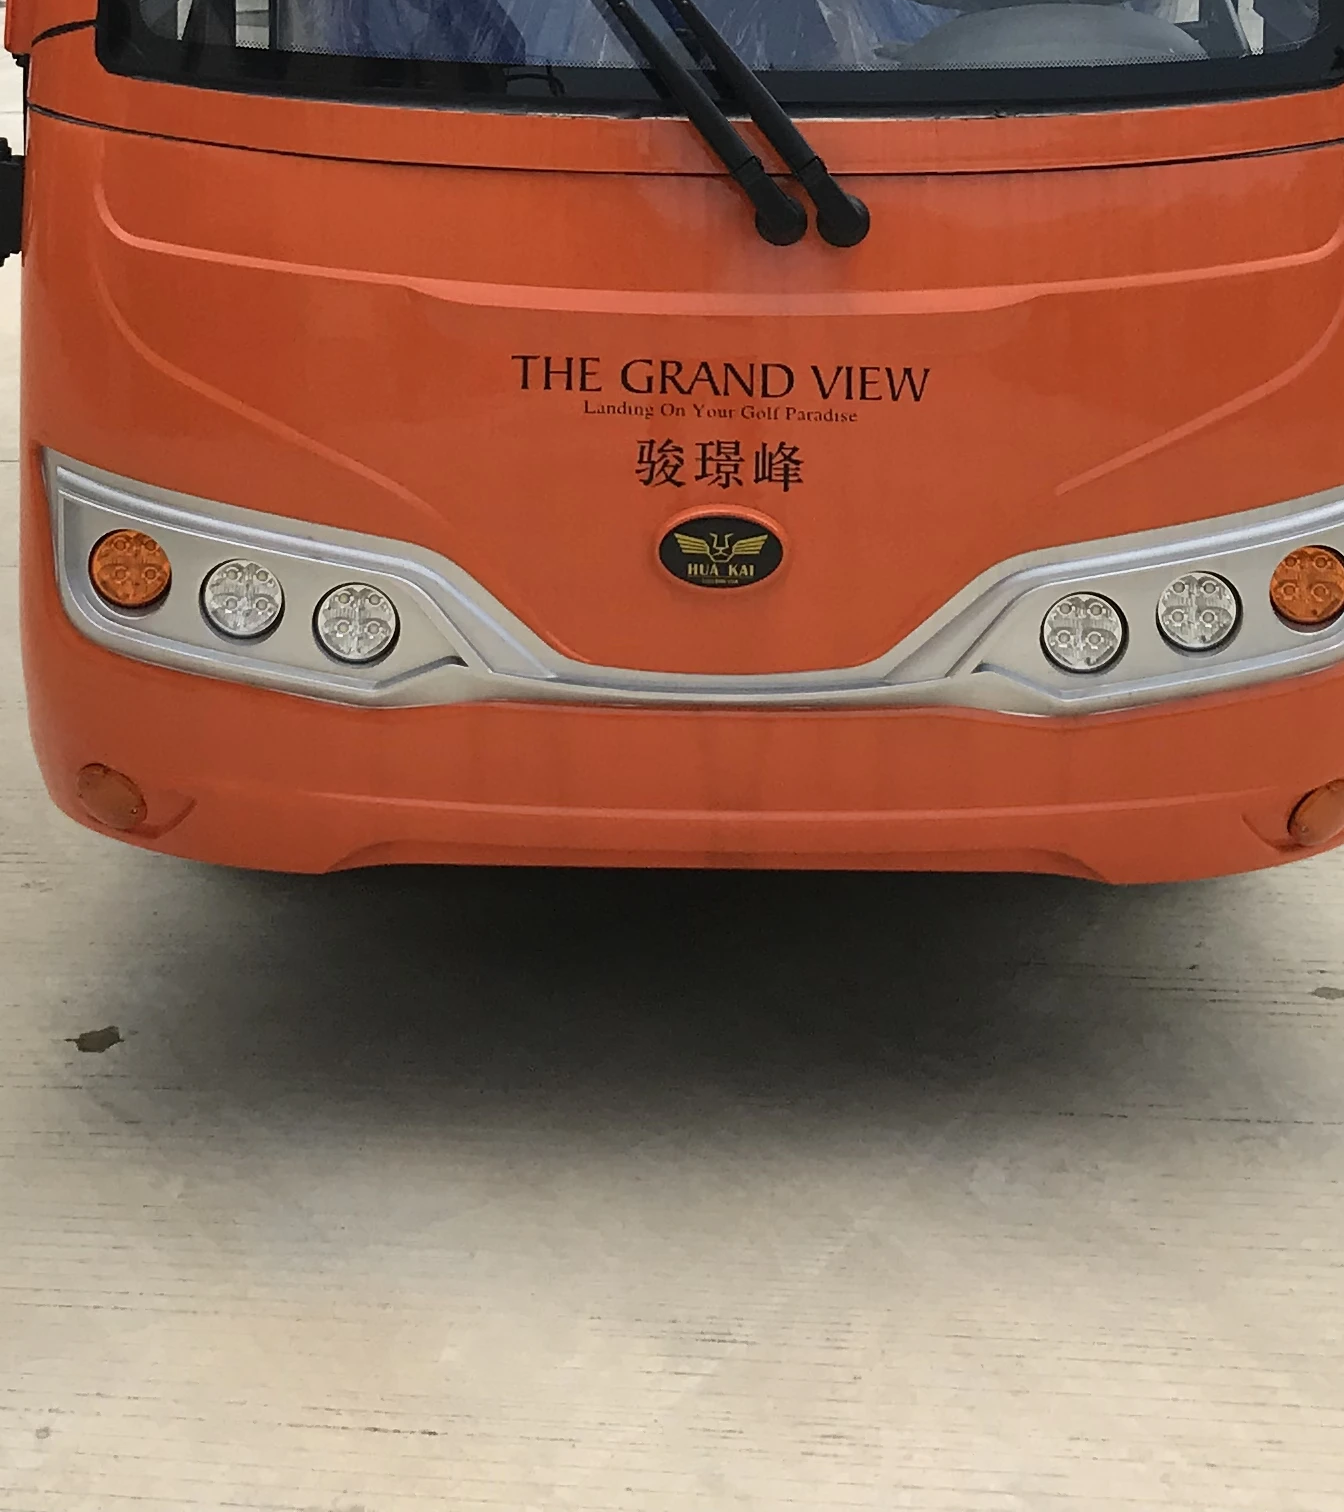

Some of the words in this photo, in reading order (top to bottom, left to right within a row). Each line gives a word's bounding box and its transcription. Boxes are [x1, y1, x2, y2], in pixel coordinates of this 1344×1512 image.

[511, 354, 602, 392] THE
[620, 358, 795, 398] GRAND
[810, 365, 931, 403] VIEW
[583, 399, 654, 420] Landing
[660, 403, 686, 417] On
[692, 404, 736, 419] Your
[740, 405, 781, 421] Golf
[785, 407, 859, 423] Paradise
[634, 437, 805, 493] 骏璟峰
[687, 563, 719, 577] HUA
[728, 564, 754, 577] KAI
